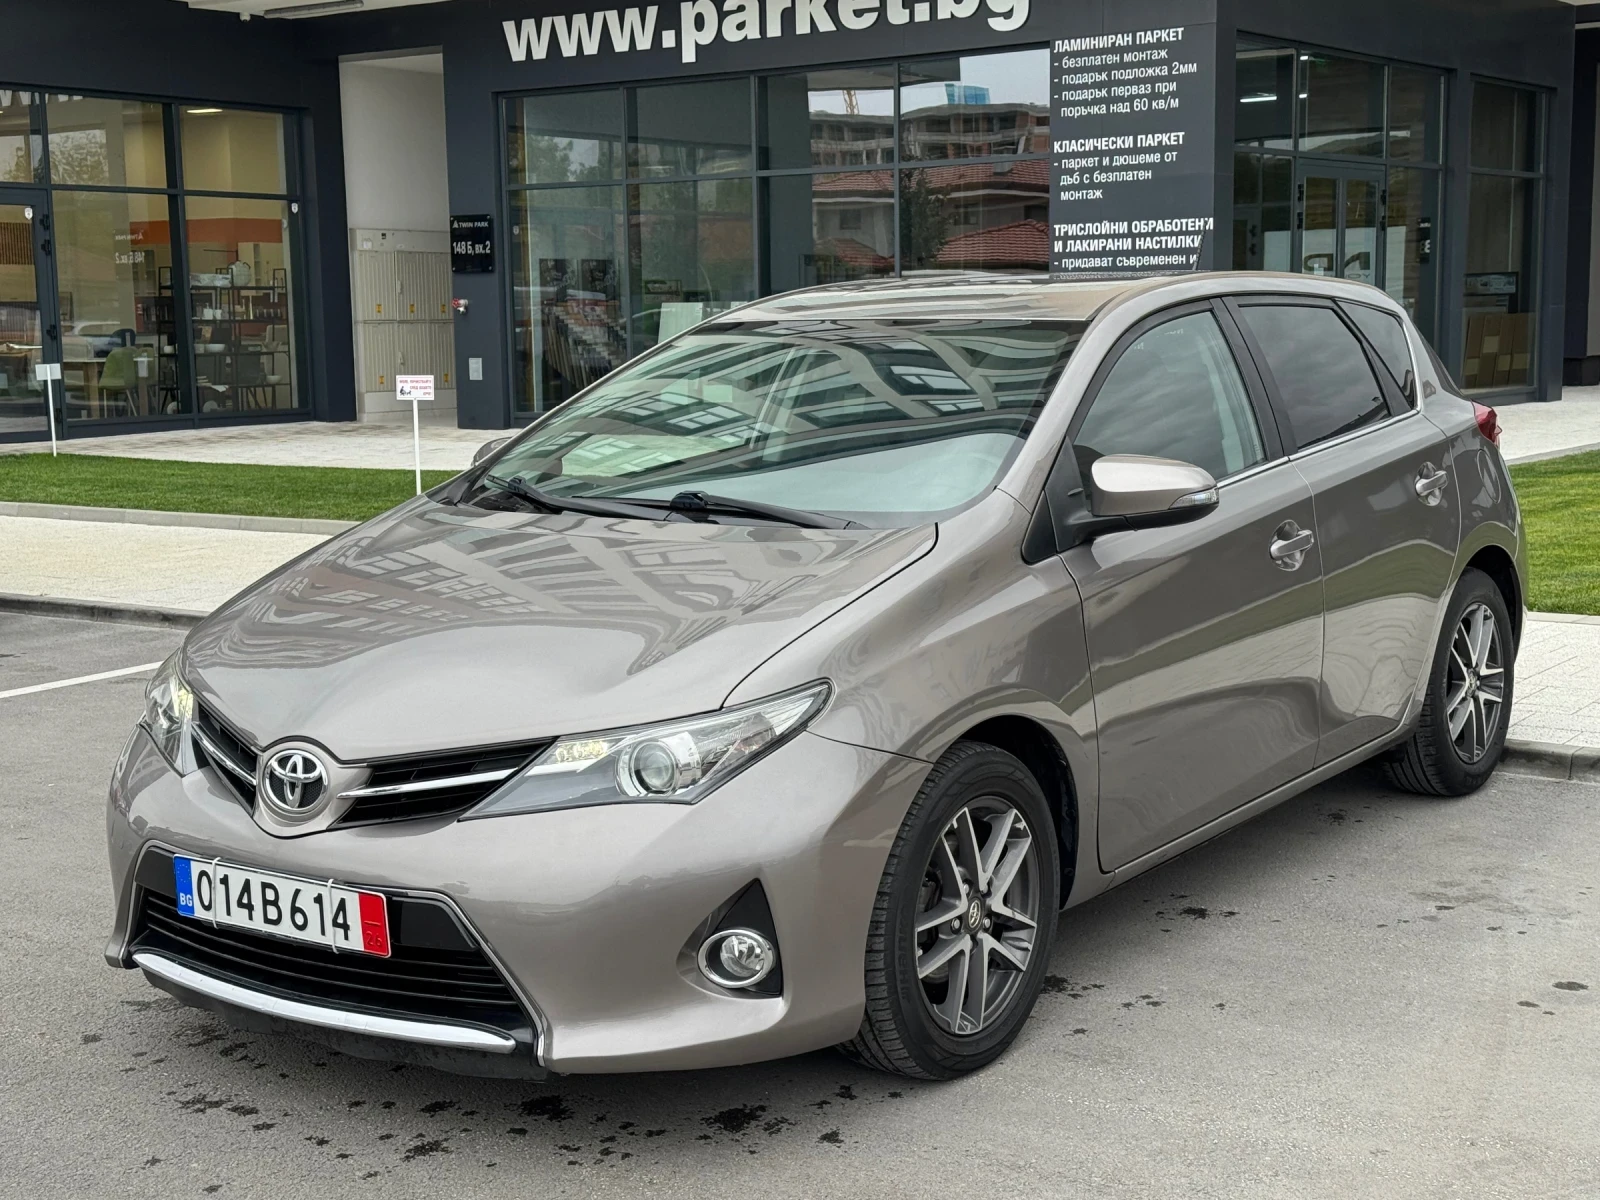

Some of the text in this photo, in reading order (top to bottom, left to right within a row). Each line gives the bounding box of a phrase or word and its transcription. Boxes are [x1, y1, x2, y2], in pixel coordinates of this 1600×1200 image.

[1054, 27, 1184, 53] ЛАМИНИРАН ПАРКЕТ
[1062, 54, 1120, 68] безплатен
[1124, 48, 1168, 62] монтаж
[1062, 71, 1108, 85] подарък
[1111, 66, 1168, 80] подложка
[1172, 62, 1197, 75] 2мм
[1062, 87, 1108, 101] подарък
[1111, 84, 1152, 98] перваз
[1155, 82, 1176, 94] при
[1061, 95, 1179, 118] поръчка над 60 кв/м
[1054, 132, 1185, 153] КЛАСИЧЕСКИ ПАРКЕТ
[1062, 156, 1099, 170] паркет
[1102, 156, 1109, 166] и
[1112, 152, 1160, 166] дюшеме
[1164, 151, 1178, 162] от
[1060, 168, 1152, 186] дъб с безплатен
[1060, 188, 1102, 200] монтаж
[1054, 218, 1214, 236] ТРИСЛОЙНИ ОБРАБОТЕНИ
[452, 241, 466, 254] 148
[1054, 235, 1202, 252] И ЛАКИРАНИ НАСТИЛКИ
[1062, 256, 1113, 270] придават
[1116, 254, 1186, 268] съвременен
[180, 892, 192, 906] BG
[196, 869, 350, 941] 014B614
